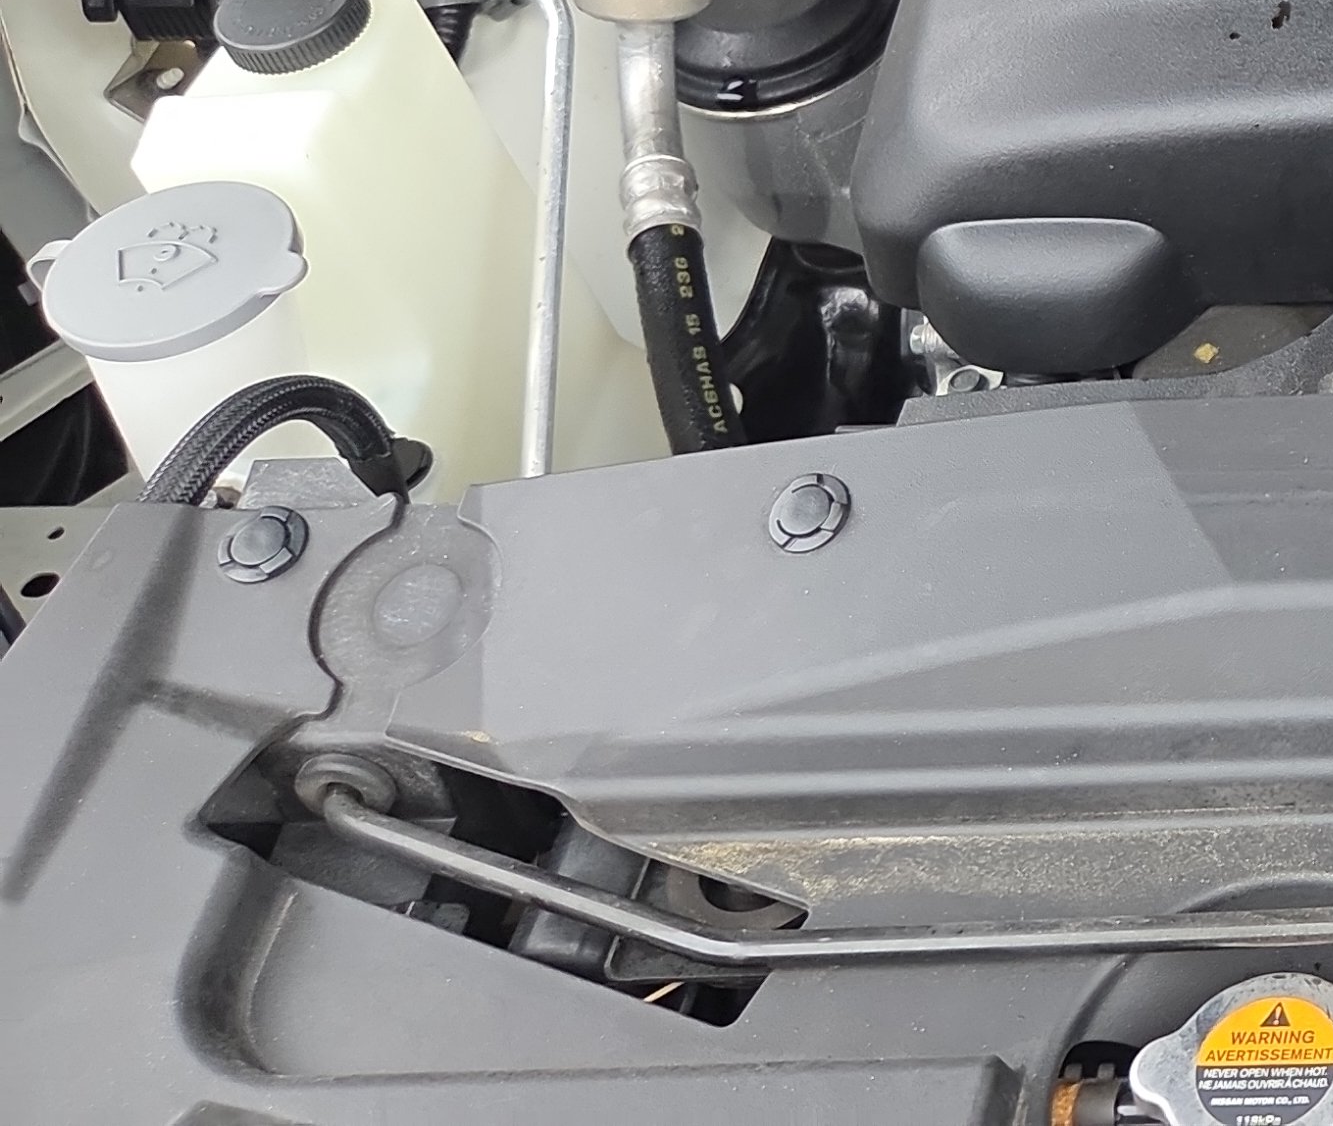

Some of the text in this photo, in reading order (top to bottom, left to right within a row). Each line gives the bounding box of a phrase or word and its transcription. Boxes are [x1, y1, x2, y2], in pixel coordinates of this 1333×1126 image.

[1231, 1030, 1315, 1045] WARNING
[1205, 1048, 1333, 1062] AVERTISSEMENT
[1203, 1068, 1238, 1079] NEVER
[1240, 1068, 1269, 1078] OPEN
[1271, 1068, 1303, 1077] WHEN
[1198, 1080, 1213, 1090] NE
[1212, 1080, 1246, 1090] JAMAIS
[1247, 1079, 1285, 1089] OUVRIR
[1211, 1098, 1242, 1106] NISSAN
[1244, 1097, 1274, 1105] MOTOR
